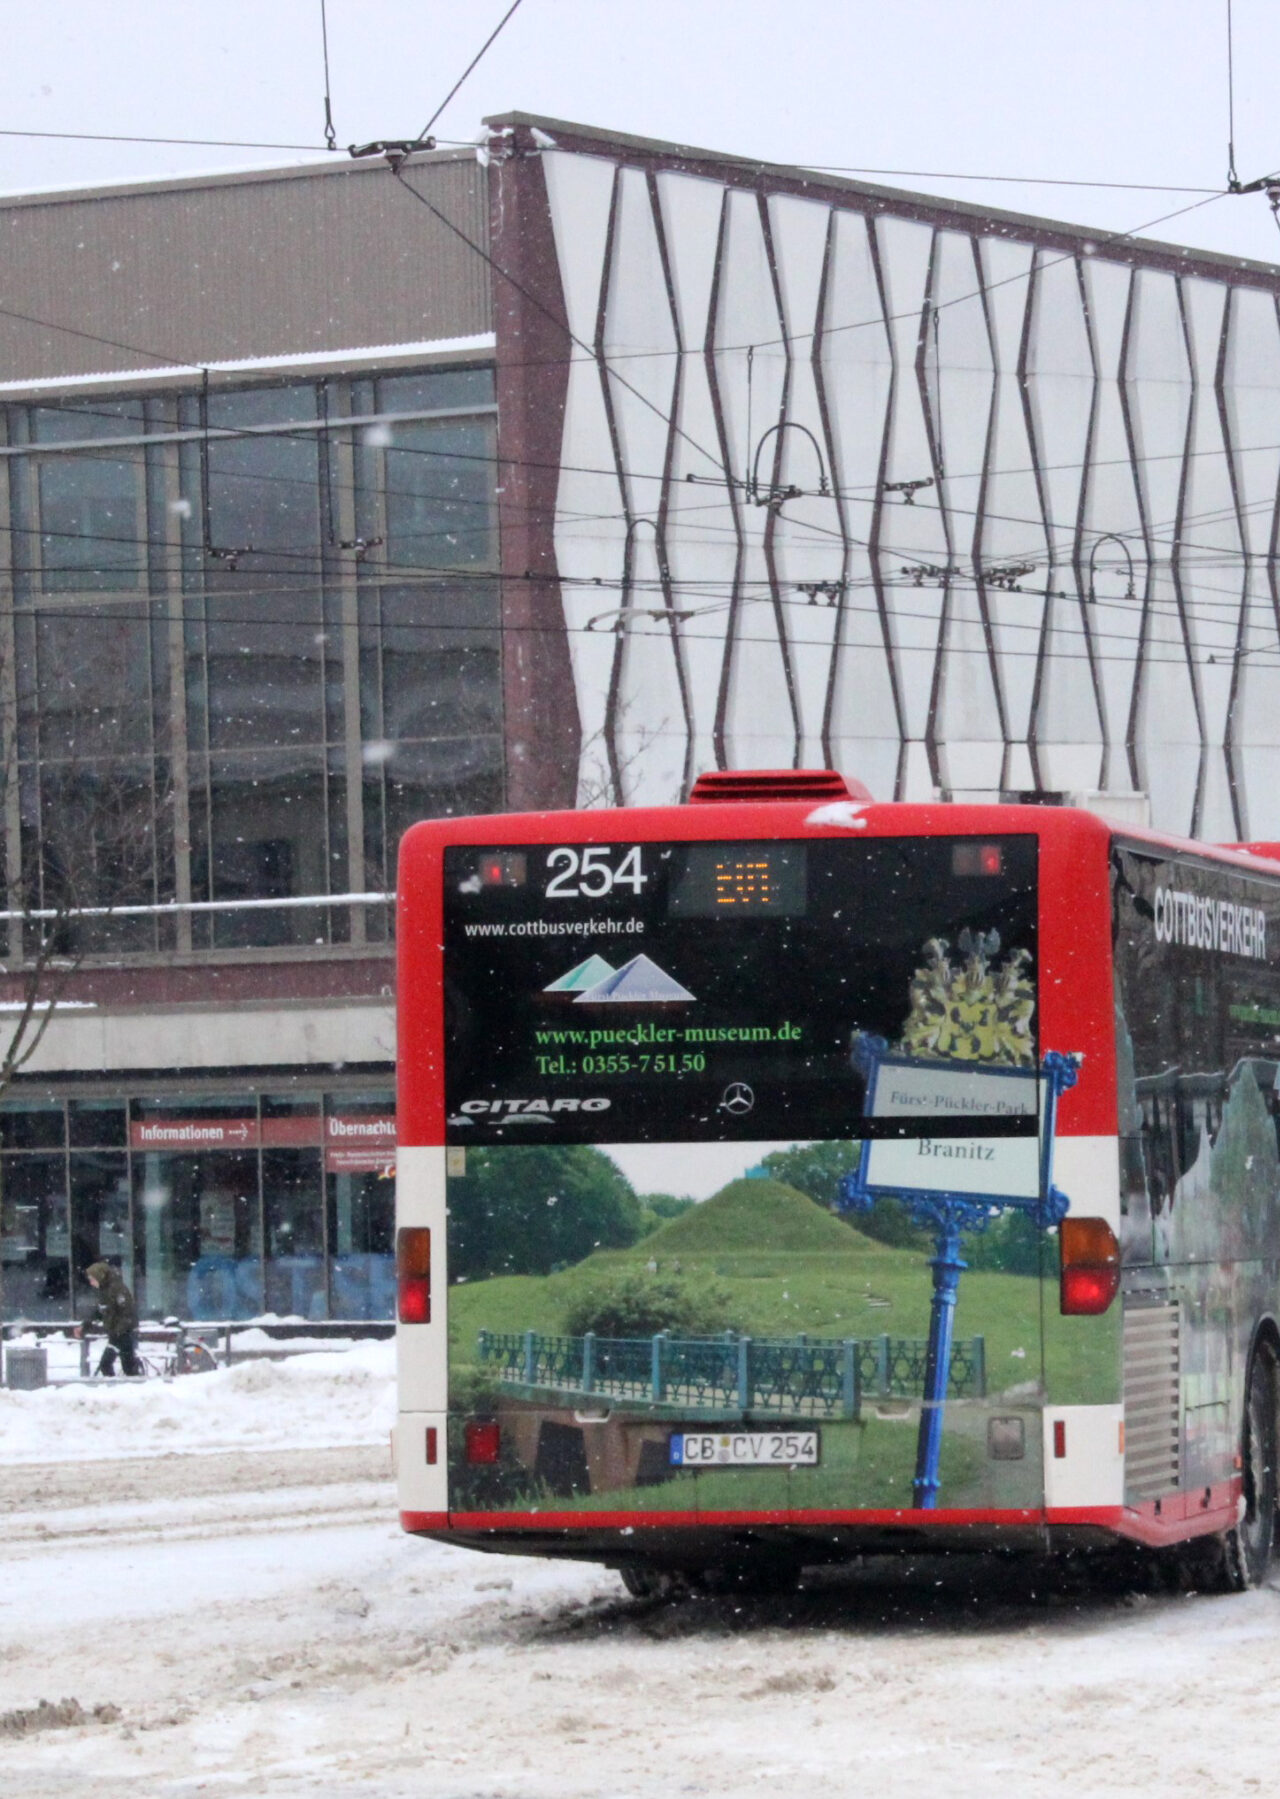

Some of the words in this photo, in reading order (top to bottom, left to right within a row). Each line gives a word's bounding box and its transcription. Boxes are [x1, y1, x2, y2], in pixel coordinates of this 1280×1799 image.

[545, 846, 648, 899] 254
[465, 917, 645, 937] www.cottbusverkehr.de
[1154, 886, 1267, 960] COTTBUSVERKEHR
[535, 1021, 802, 1048] www.pueckler-museum.de
[536, 1055, 577, 1075] Tel.:
[460, 1098, 612, 1114] CITARO
[140, 1125, 224, 1141] Informationen
[917, 1138, 996, 1161] Branitz
[684, 1437, 715, 1460] CB
[733, 1436, 764, 1459] CV
[770, 1436, 814, 1459] 254
